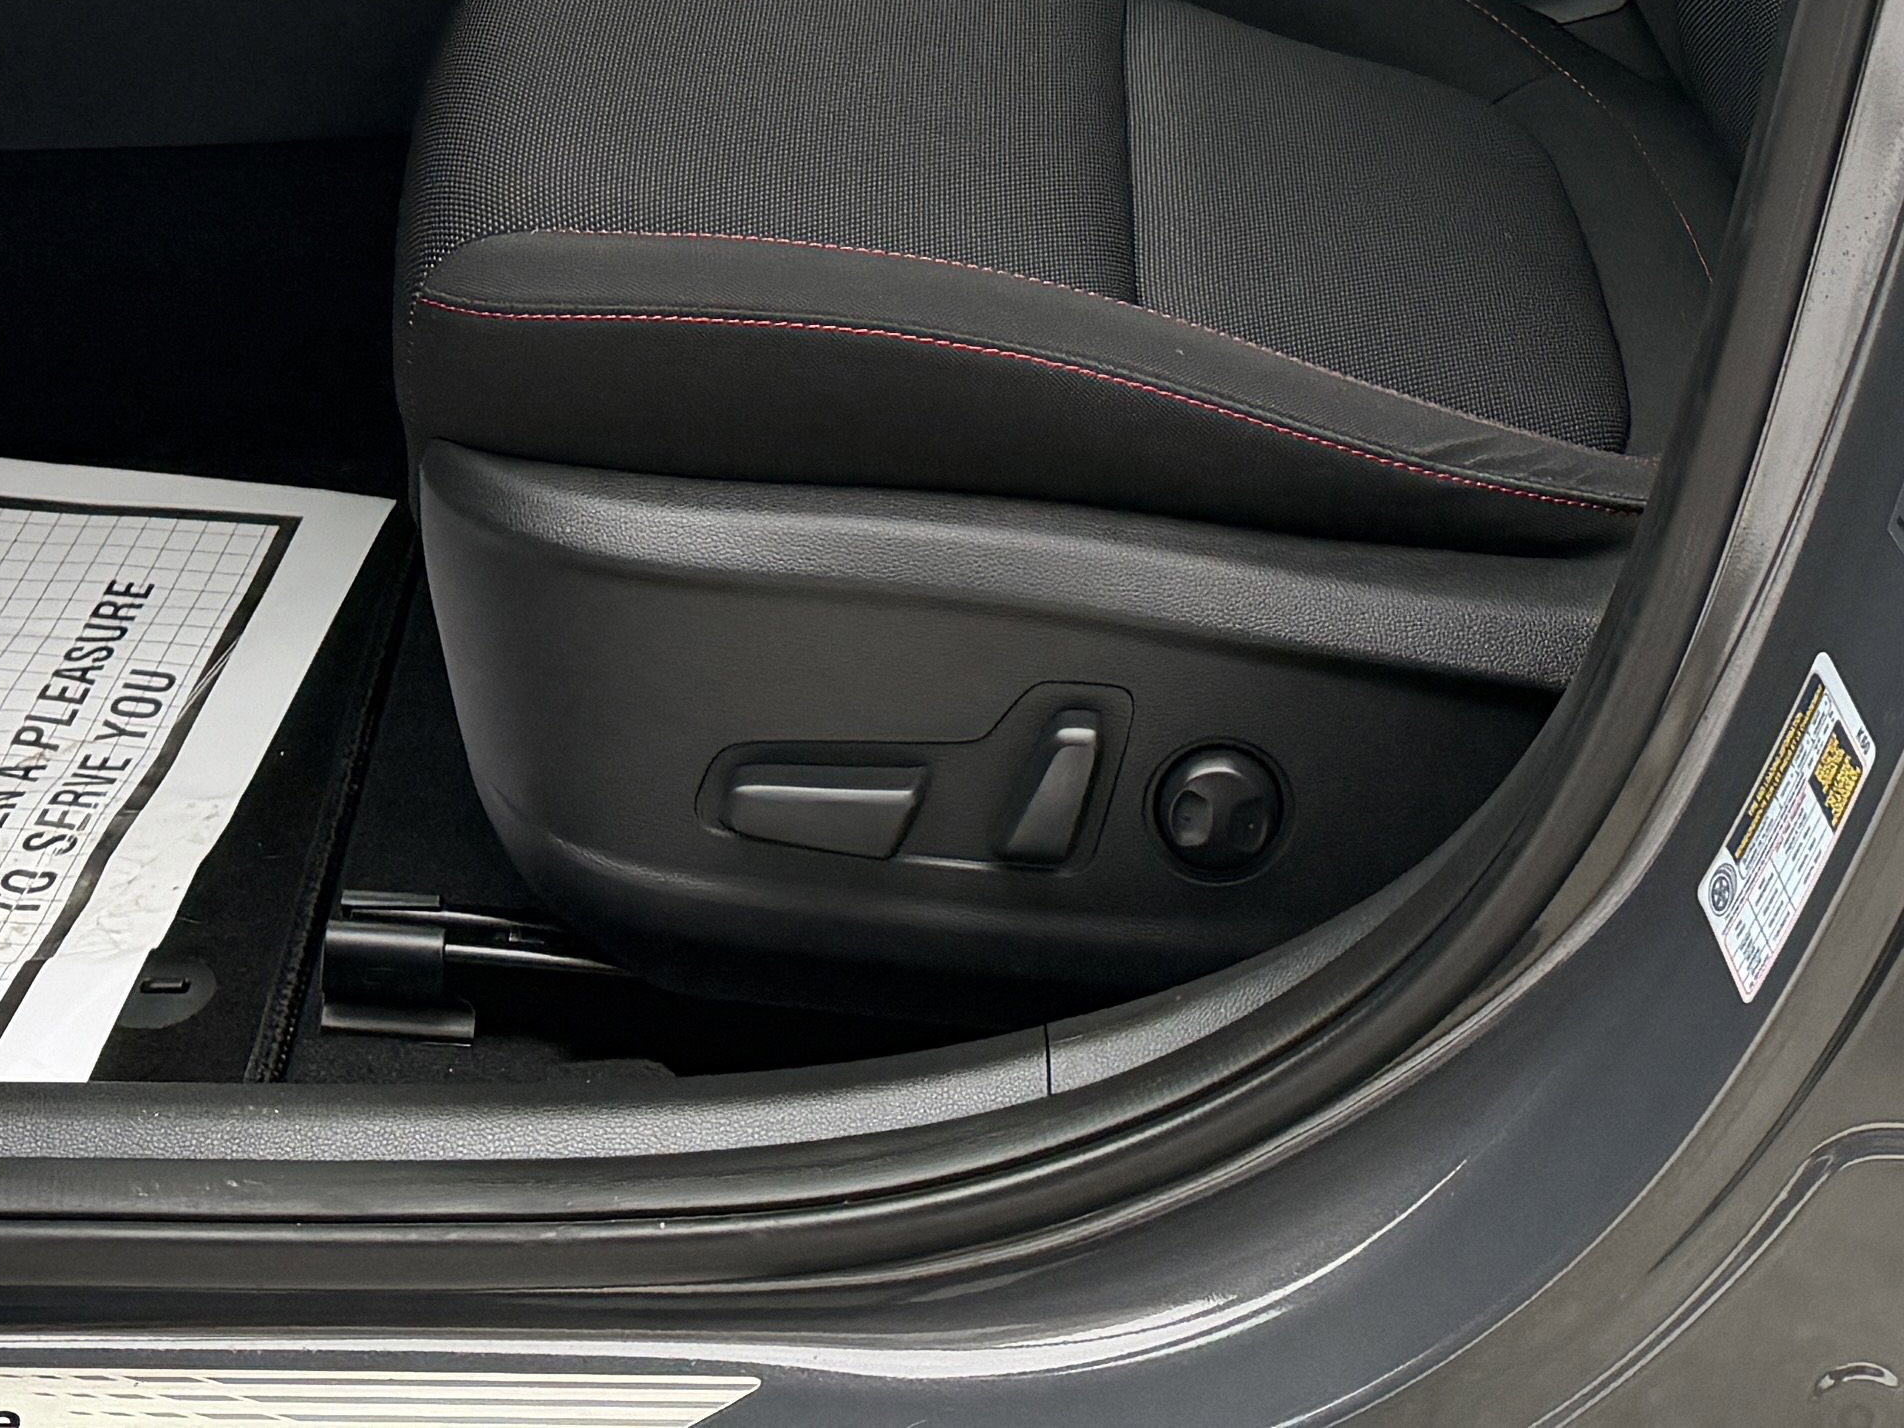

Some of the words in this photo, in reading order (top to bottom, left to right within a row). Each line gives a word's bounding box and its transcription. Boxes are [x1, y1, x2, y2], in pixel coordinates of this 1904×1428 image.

[11, 579, 155, 752] PLEASURE
[22, 753, 132, 856] SERVE
[96, 668, 177, 742] YOU
